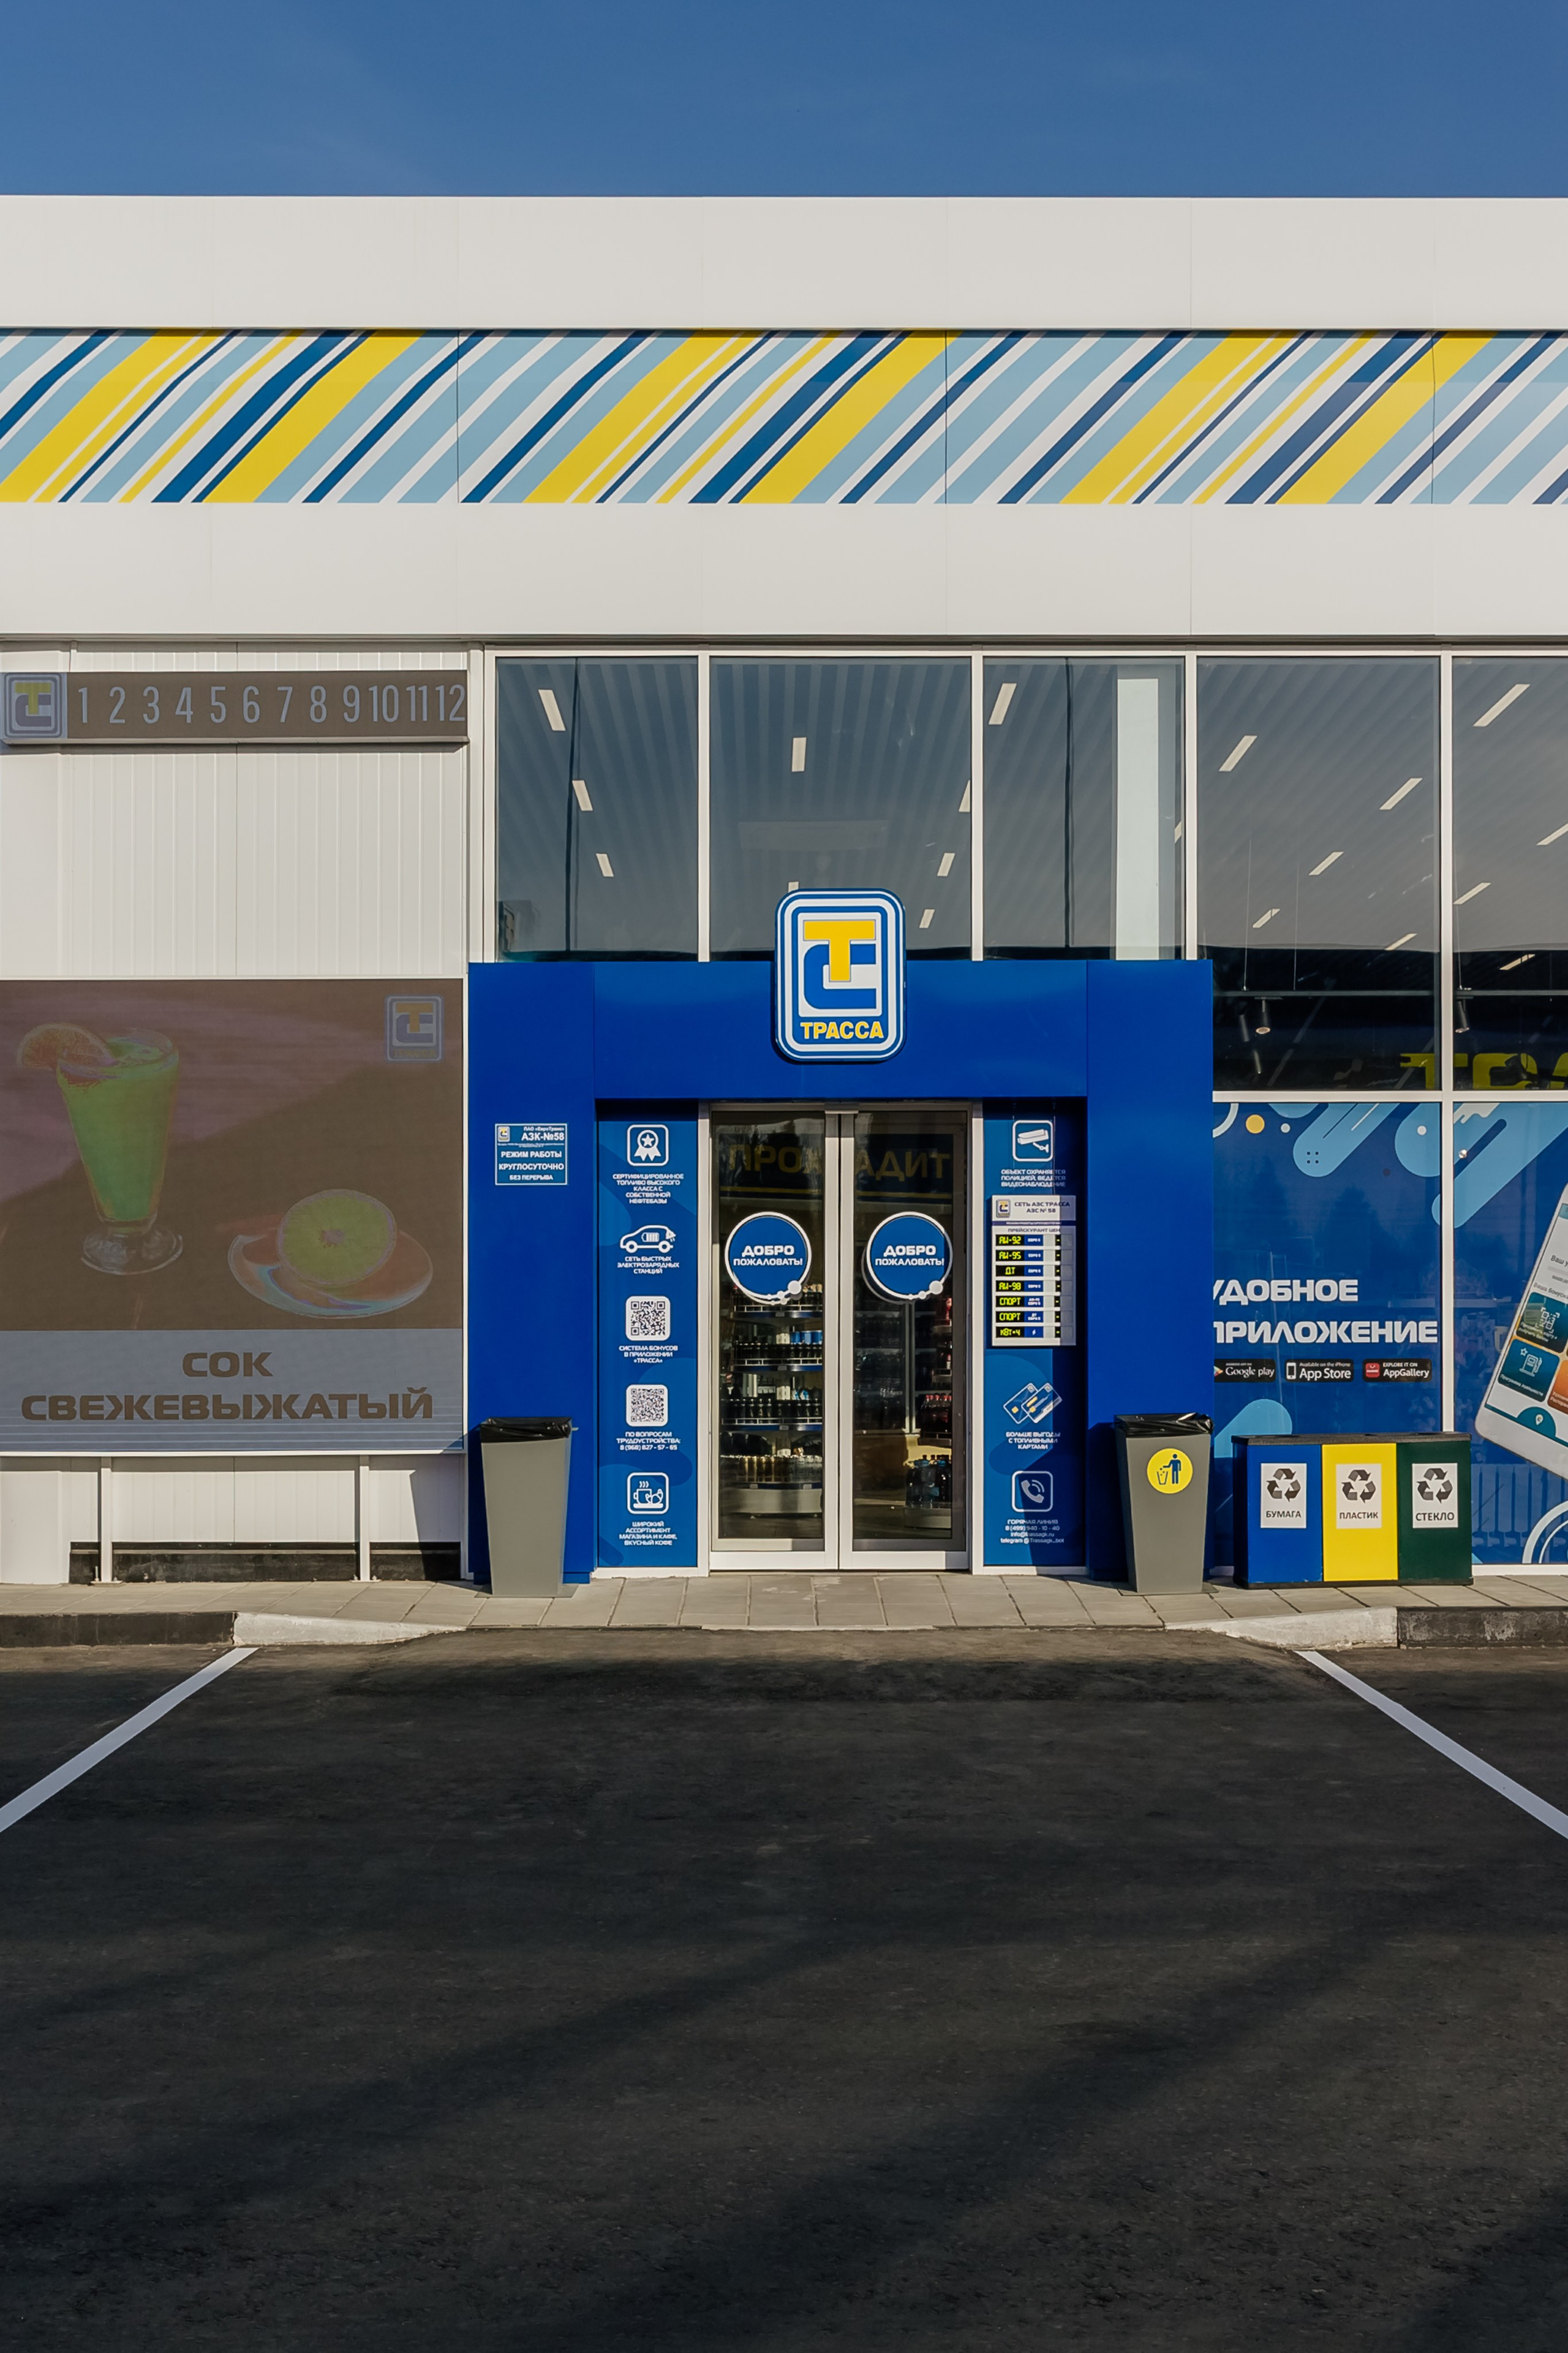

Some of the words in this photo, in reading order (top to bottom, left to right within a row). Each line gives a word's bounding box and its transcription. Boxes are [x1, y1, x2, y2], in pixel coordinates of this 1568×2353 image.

[78, 687, 88, 723] 1
[109, 687, 126, 723] 2
[143, 686, 159, 723] 3
[175, 687, 194, 723] 4
[210, 686, 227, 723] 5
[243, 686, 261, 723] 6
[277, 686, 293, 723] 7
[309, 686, 327, 723] 8
[342, 685, 361, 723] 9
[369, 684, 399, 722] 10
[405, 685, 428, 722] 11
[435, 684, 466, 722] 12
[800, 1021, 884, 1039] ТРАССА
[742, 1245, 794, 1257] ДОБРО
[883, 1245, 936, 1257] ДОБРО
[733, 1258, 802, 1266] ПОЖАЛОВАТЬ!
[875, 1258, 944, 1266] ПОЖАЛОВАТЬ!
[182, 1351, 273, 1378] СОК
[1226, 1367, 1256, 1378] Google
[1258, 1367, 1275, 1378] play
[1300, 1368, 1322, 1381] App
[1324, 1368, 1351, 1379] Store
[1383, 1369, 1430, 1378] AppGallery
[21, 1386, 433, 1421] СВЕЖЕВЫЖАТЫЙ
[1415, 1511, 1455, 1521] СТЕКЛО
